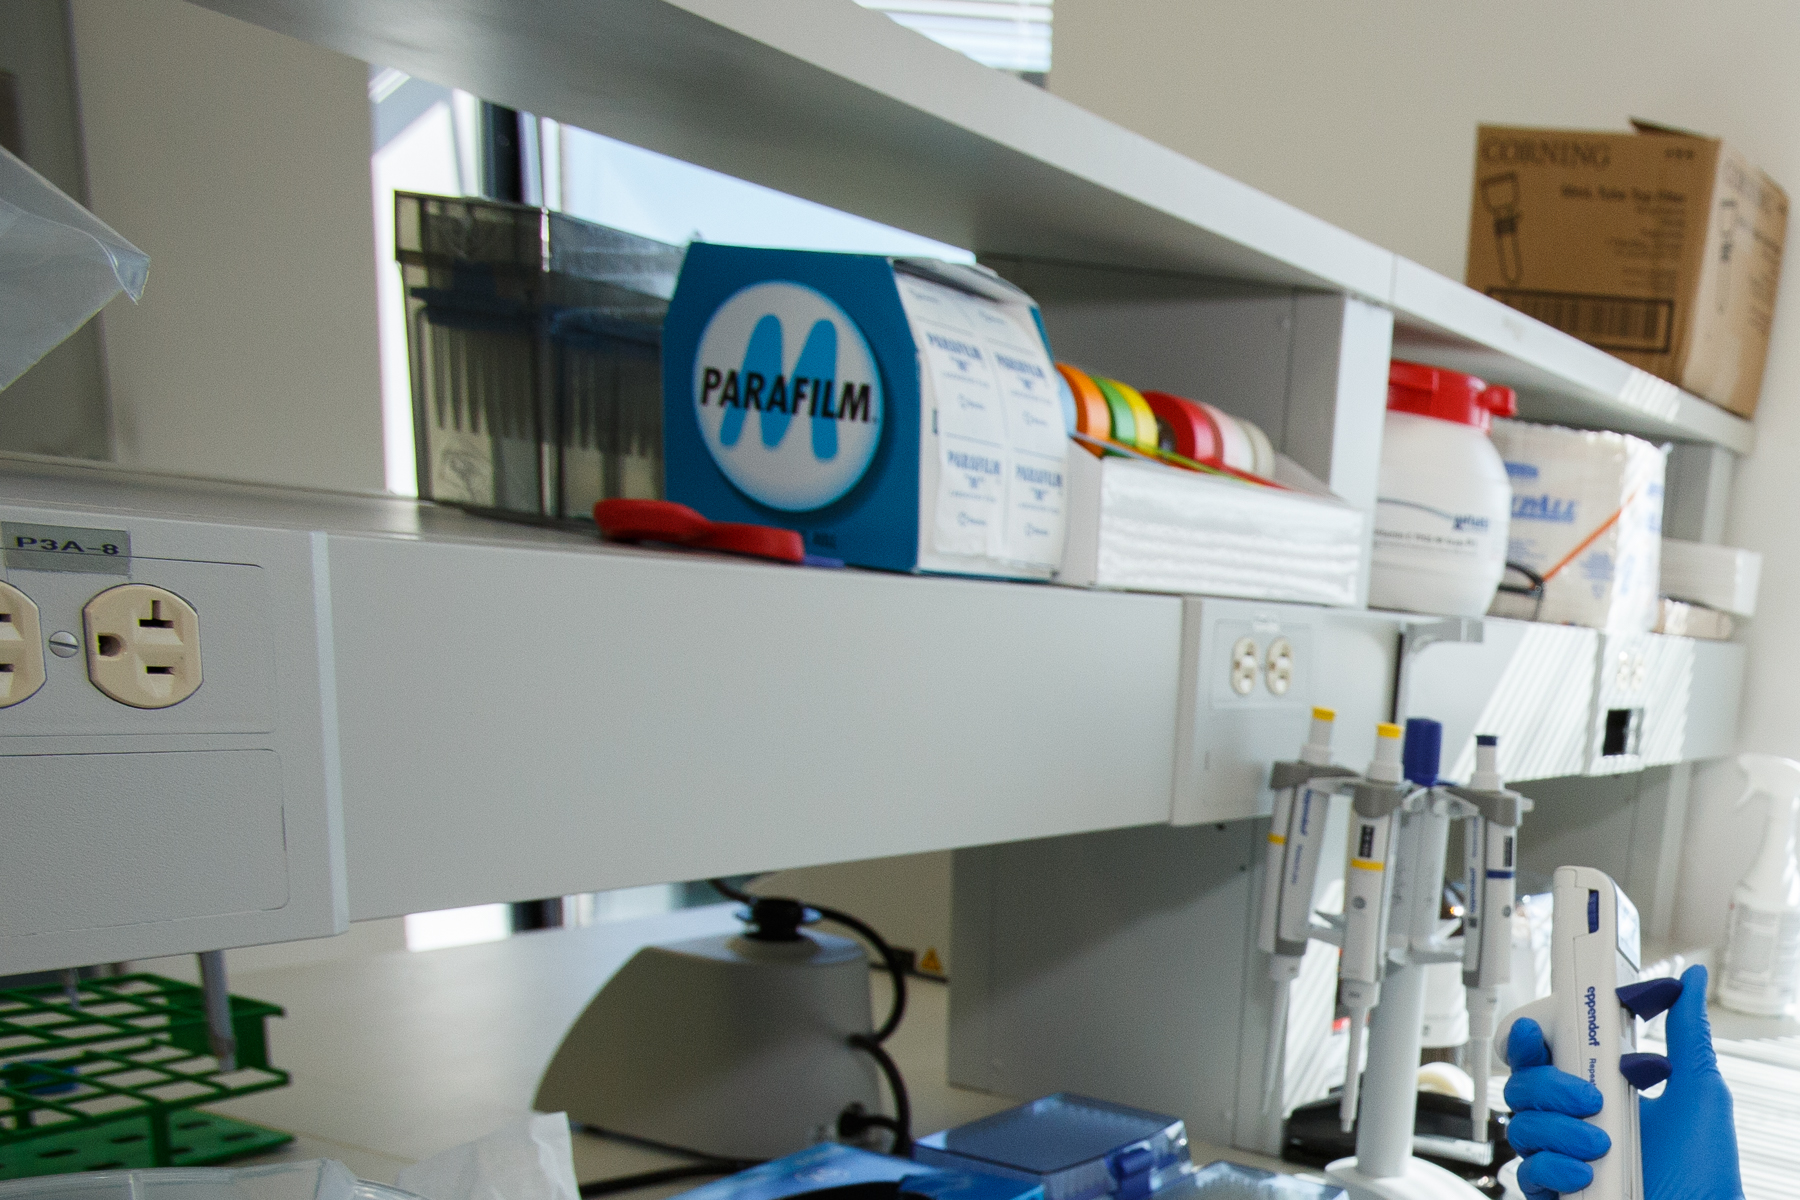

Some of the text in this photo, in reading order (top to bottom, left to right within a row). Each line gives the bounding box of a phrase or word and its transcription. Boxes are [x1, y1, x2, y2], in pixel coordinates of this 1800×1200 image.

[1481, 138, 1612, 169] CORNING
[701, 366, 870, 424] PARAFILM
[15, 536, 119, 555] P3A-8
[1585, 986, 1600, 1047] eppendorf
